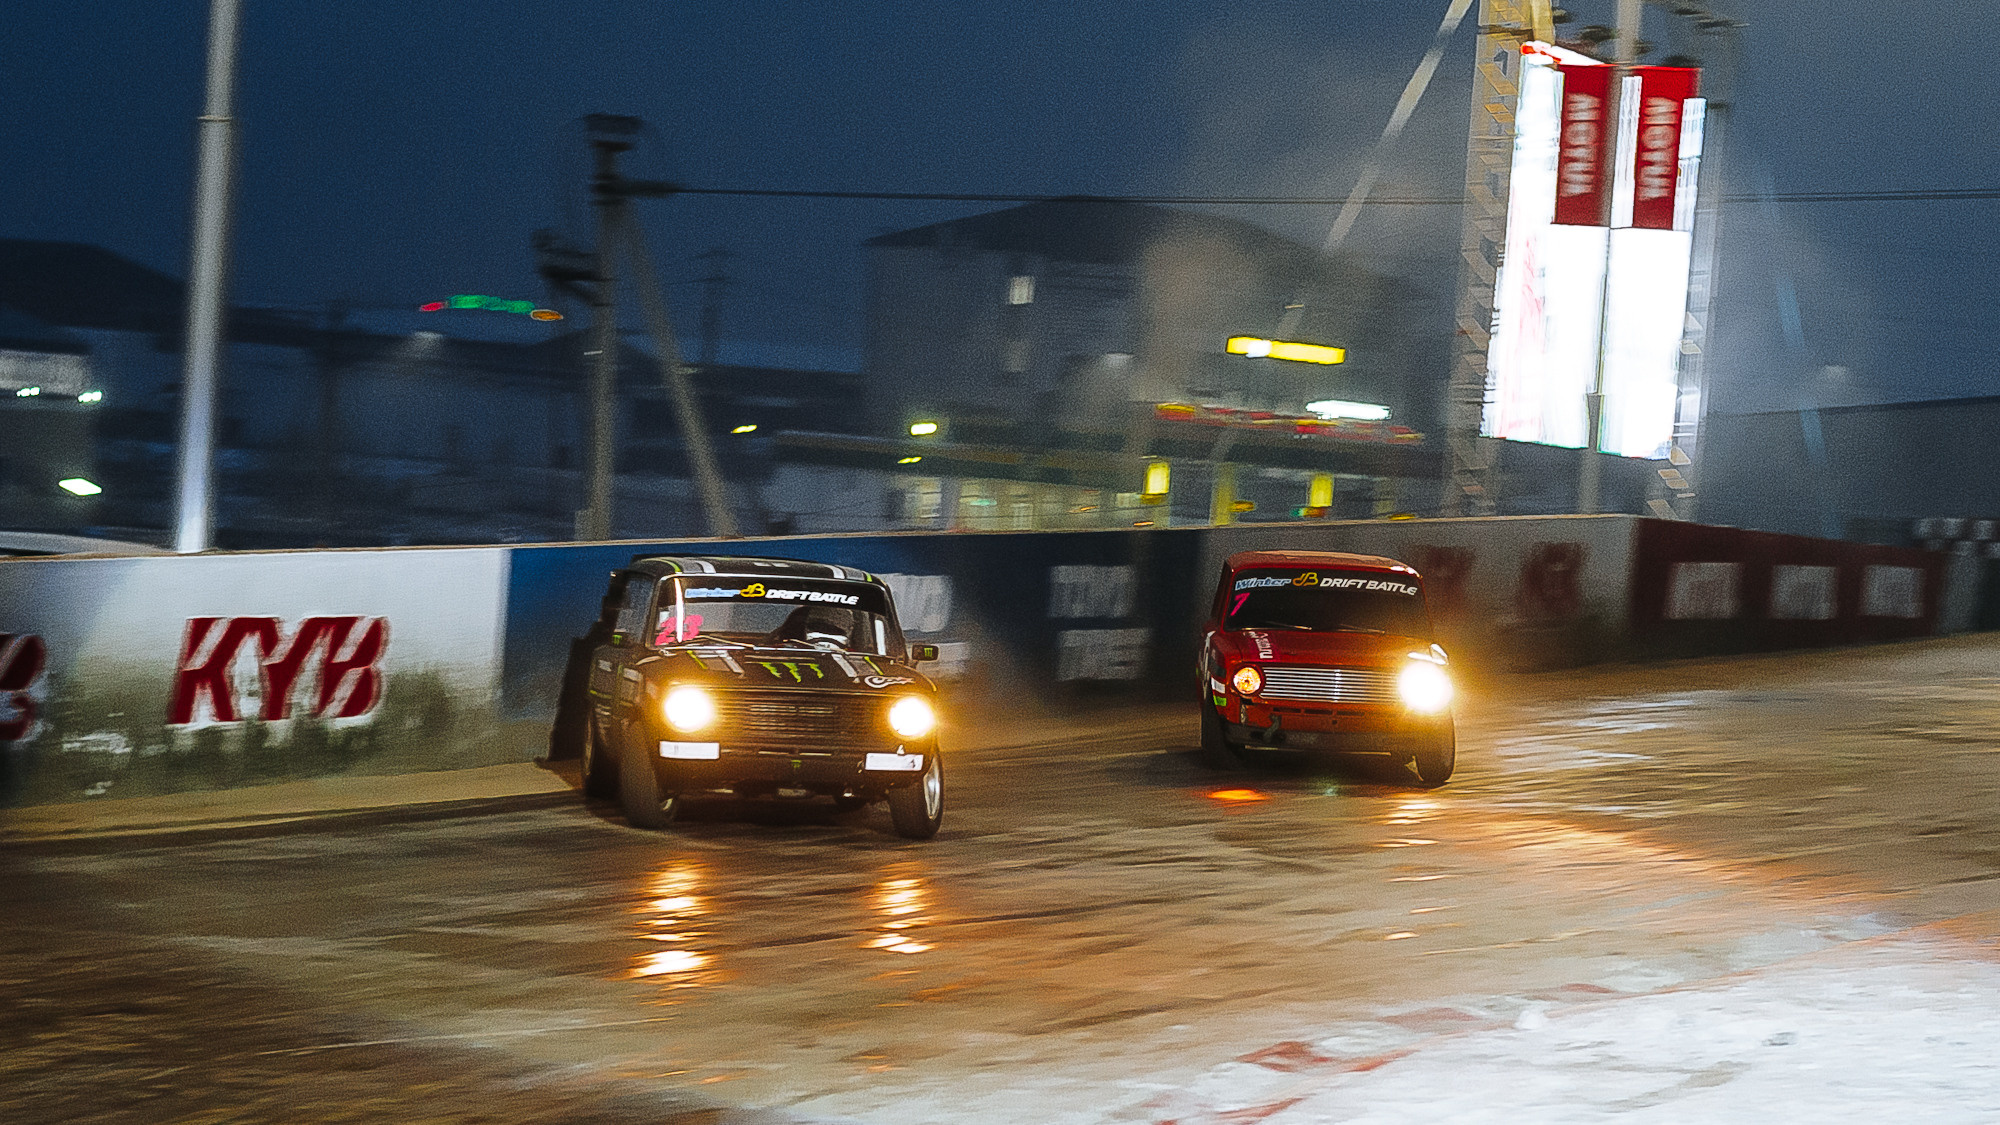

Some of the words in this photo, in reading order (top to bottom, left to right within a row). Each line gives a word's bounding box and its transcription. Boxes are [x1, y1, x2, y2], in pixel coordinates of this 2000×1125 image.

[765, 588, 811, 601] DRIFT
[809, 590, 860, 606] BATTLE
[1235, 576, 1292, 591] Winter
[1320, 577, 1367, 590] DRIFT
[1365, 580, 1418, 596] BATTLE
[1230, 592, 1250, 617] 7
[167, 615, 392, 728] KYB
